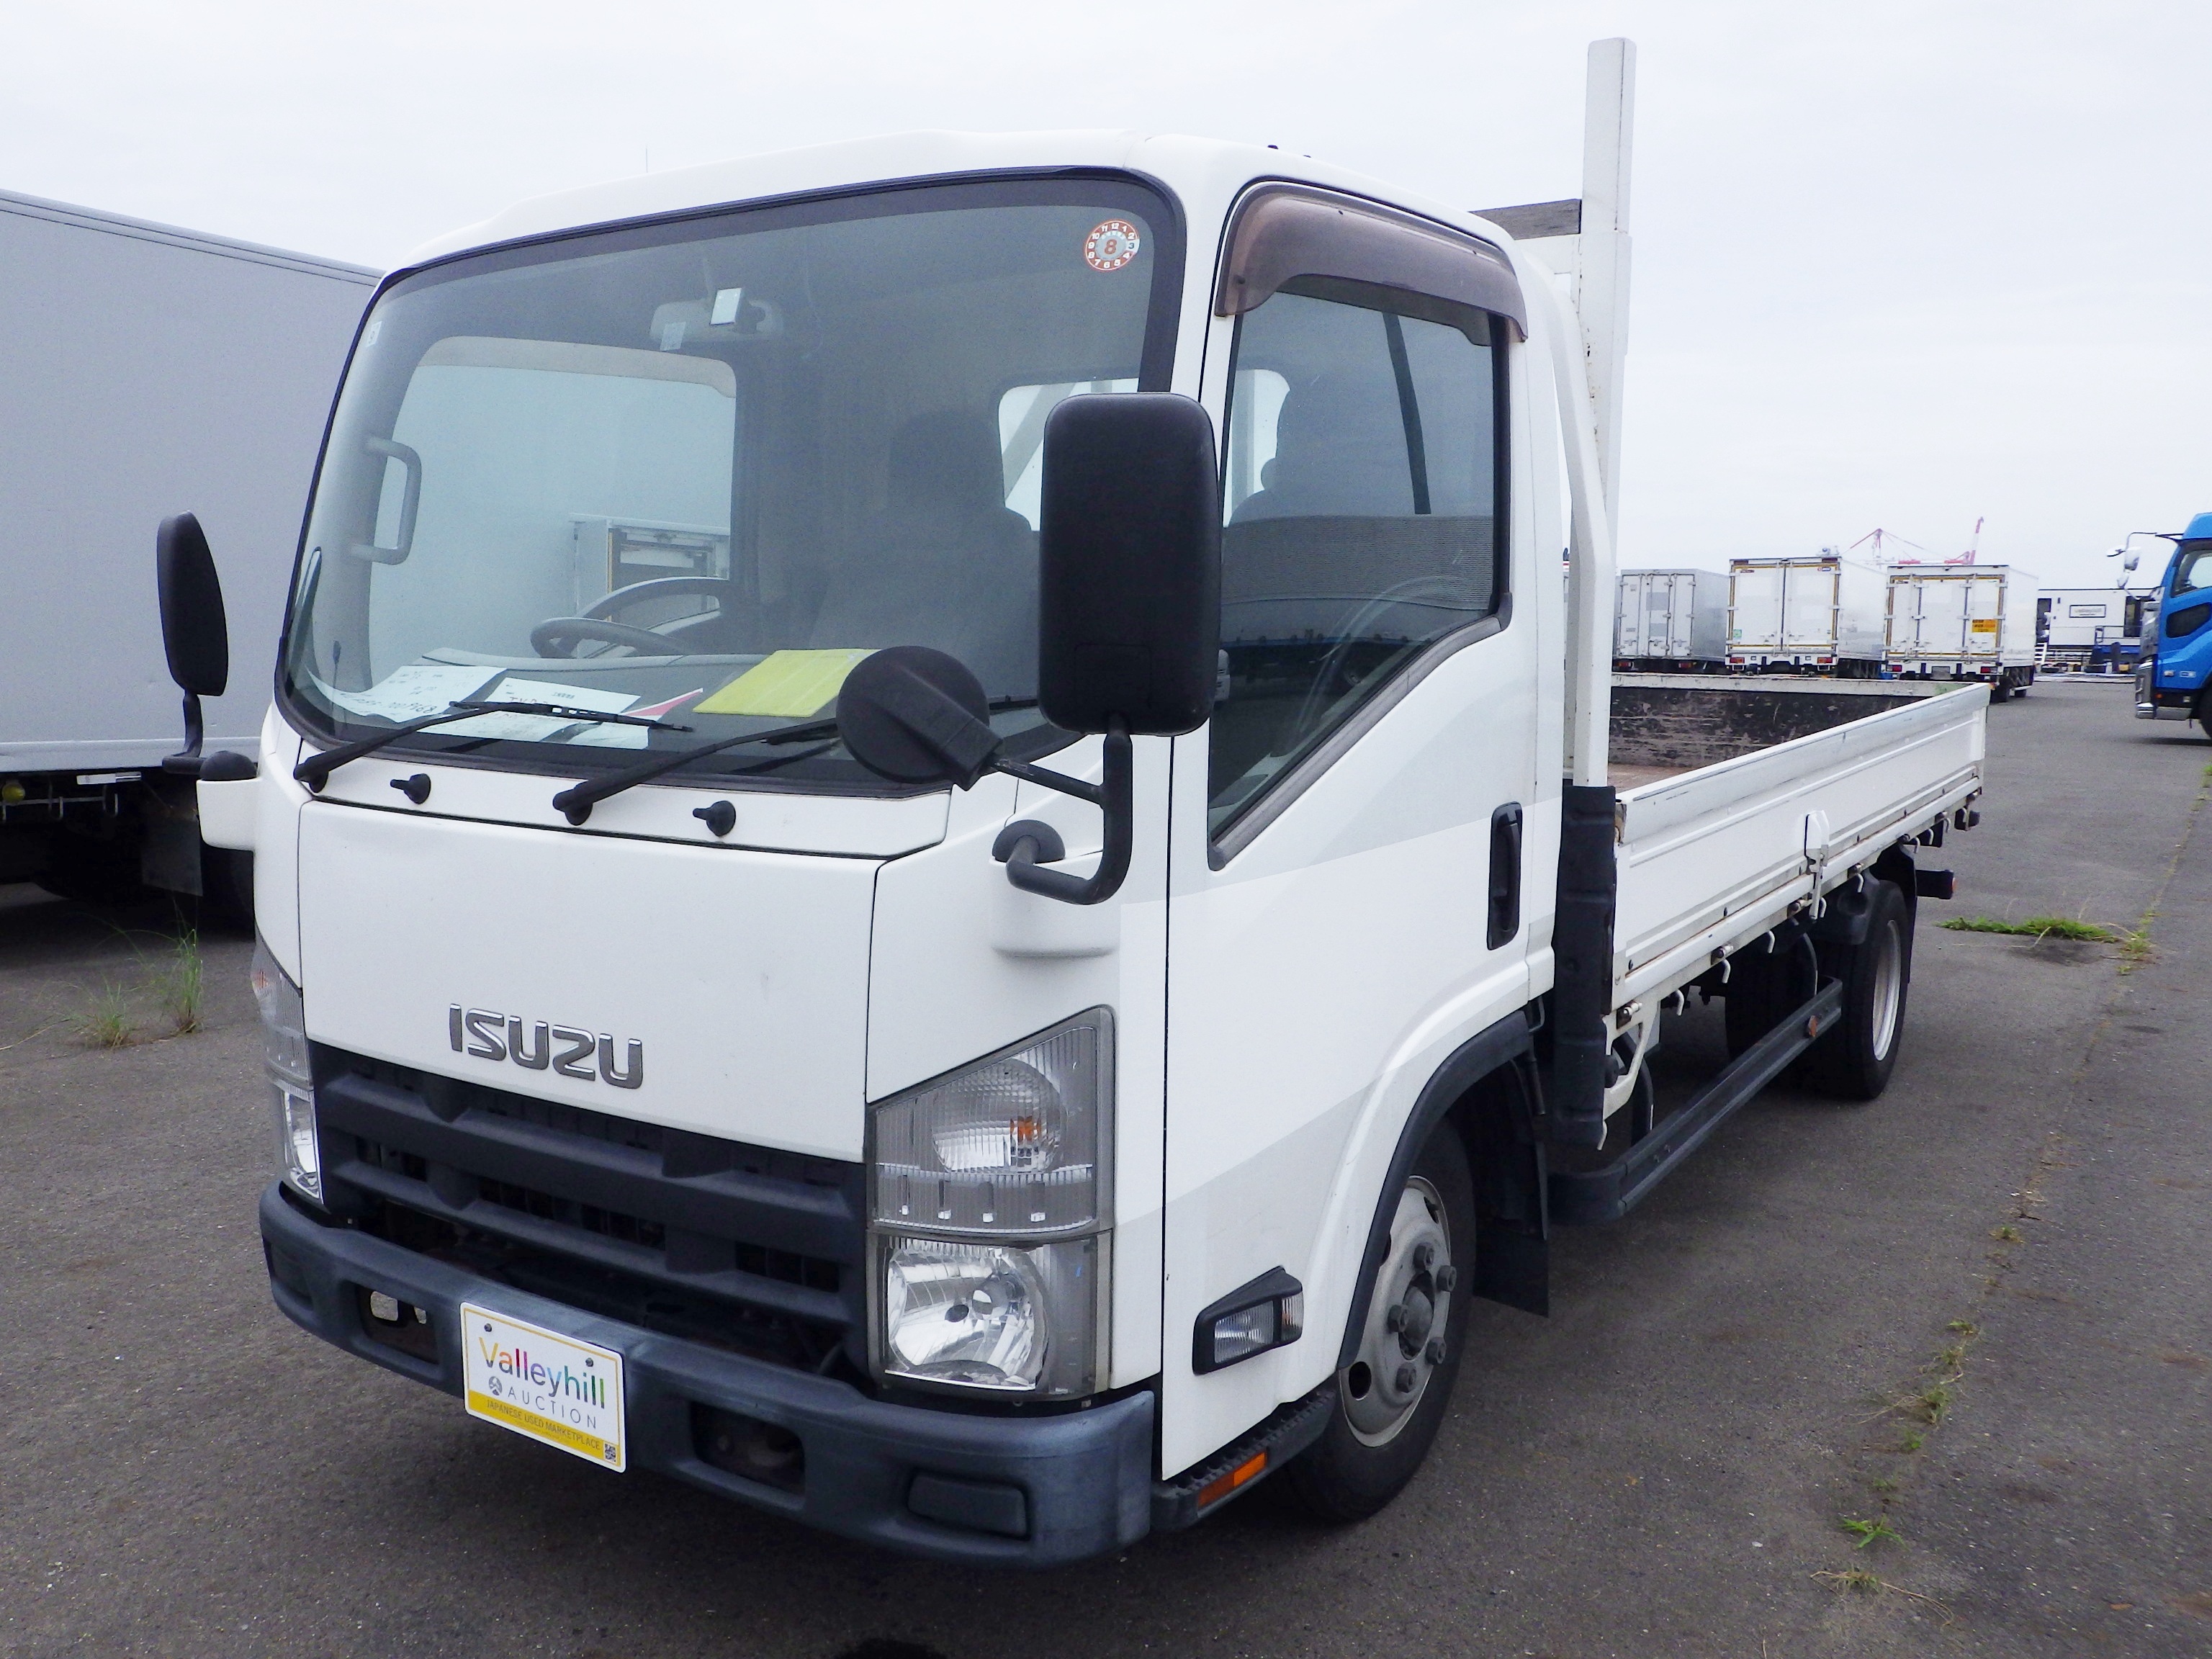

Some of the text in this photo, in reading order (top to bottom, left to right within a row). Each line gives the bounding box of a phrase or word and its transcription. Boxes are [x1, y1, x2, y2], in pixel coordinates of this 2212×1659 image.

[1105, 239, 1117, 254] 8
[449, 1003, 642, 1089] ISUZU
[479, 1336, 605, 1408] Valleyhill
[487, 1399, 522, 1419] JAPANESE
[524, 1413, 544, 1428] USED
[545, 1421, 600, 1450] MARKETPLACE
[508, 1386, 596, 1429] AUCTION
